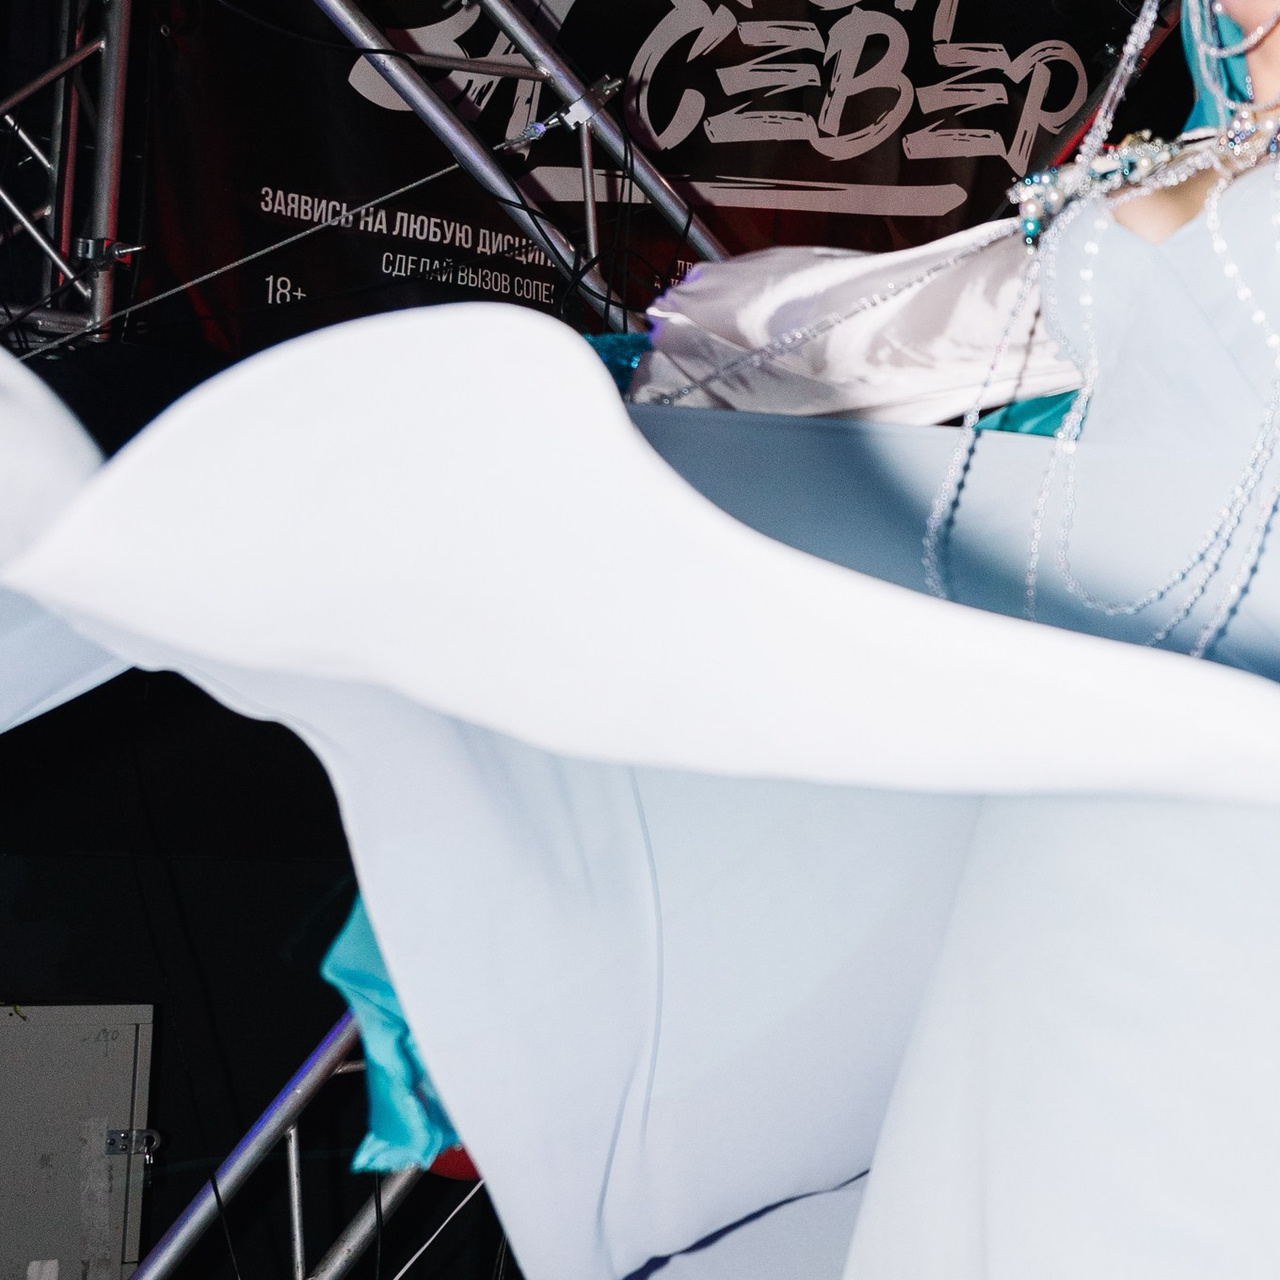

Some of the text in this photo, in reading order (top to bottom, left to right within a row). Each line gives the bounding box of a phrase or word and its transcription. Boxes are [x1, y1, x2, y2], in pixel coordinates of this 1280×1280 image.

[260, 186, 354, 228] ЗАЯВИСЬ
[359, 207, 388, 235] НА
[392, 211, 473, 249] ЛЮБУЮ
[264, 275, 307, 304] 18+
[381, 252, 454, 284] СДЕЛАЙ
[457, 264, 511, 294] ВЫЗОВ
